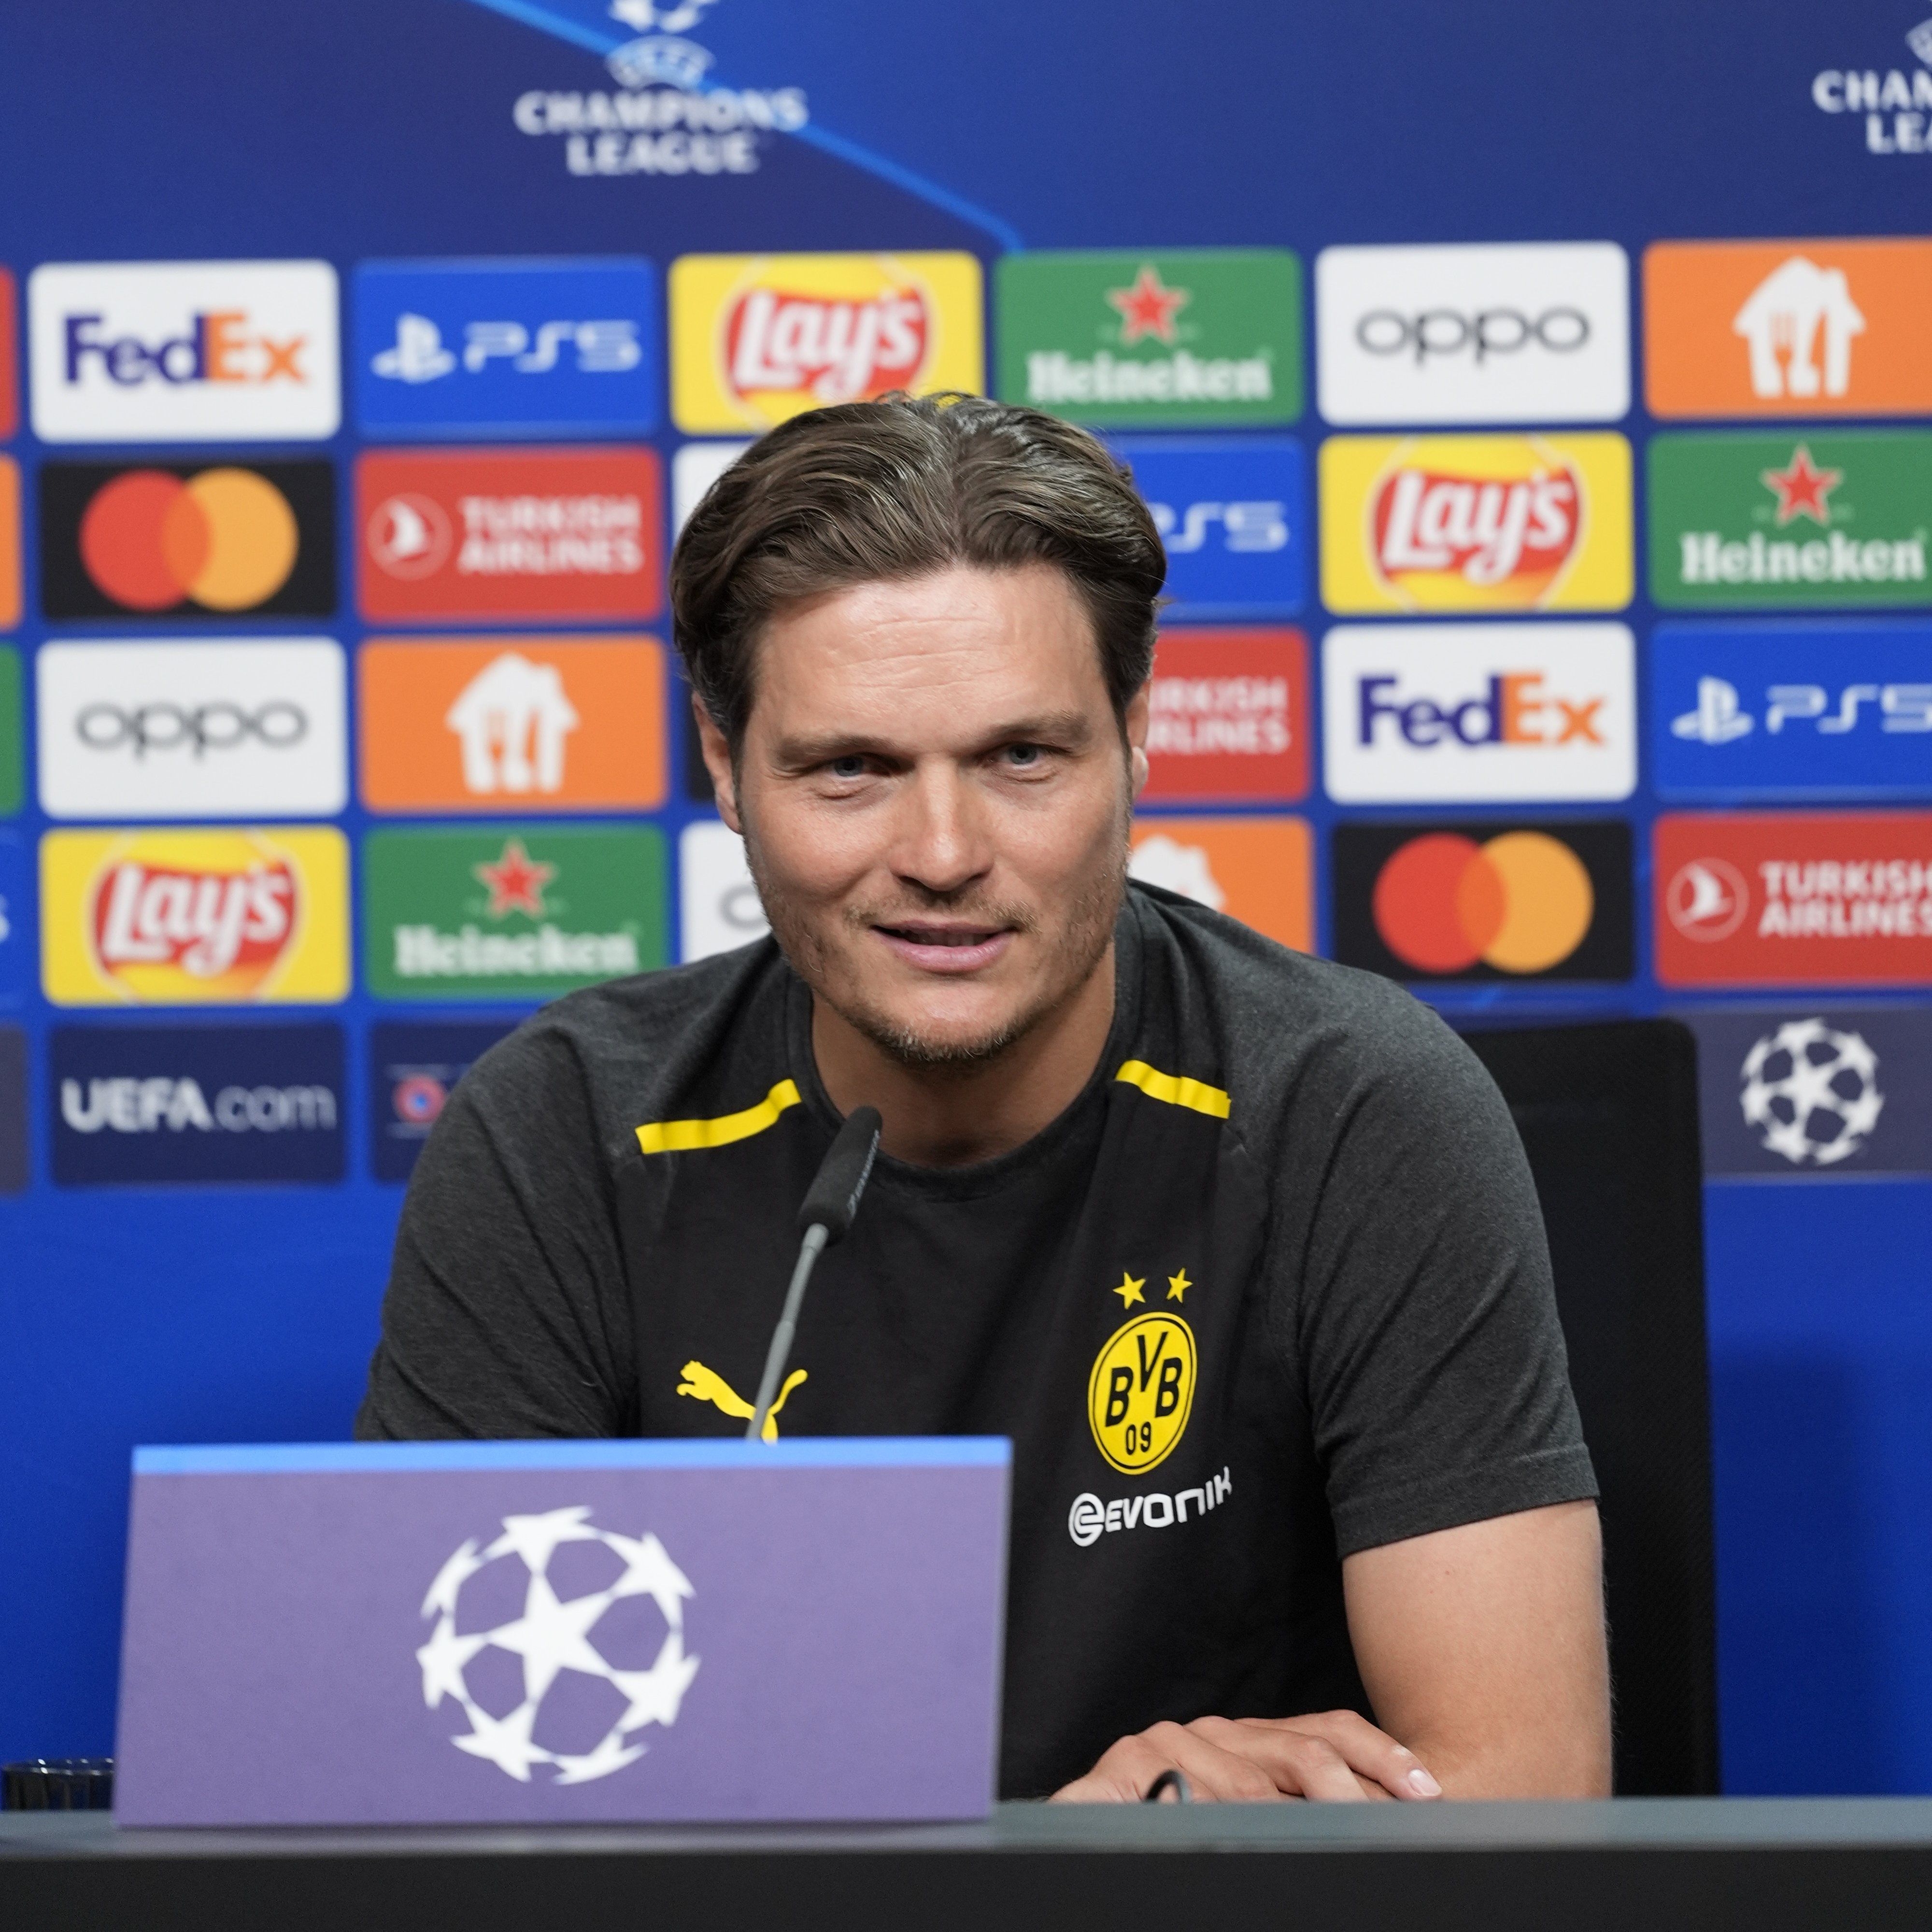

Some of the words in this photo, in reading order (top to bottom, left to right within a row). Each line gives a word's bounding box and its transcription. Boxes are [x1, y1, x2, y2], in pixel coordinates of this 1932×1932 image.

[514, 88, 809, 134] CHAMPIONS
[567, 132, 758, 175] LEAGUE
[64, 312, 303, 386] FedEx
[464, 321, 641, 372] PS5
[733, 286, 925, 405] Lay's
[1027, 350, 1271, 402] Heineken
[459, 495, 642, 533] TURKISH
[1382, 469, 1576, 584] Lay's
[458, 535, 644, 575] AIRLINES
[1680, 530, 1926, 583] Heineken
[1357, 673, 1603, 749] FedEx
[1766, 684, 1932, 733] PS5
[101, 860, 289, 978] Lay's
[394, 923, 639, 976] Heineken
[61, 1077, 337, 1132] UEFA.com
[1105, 1331, 1183, 1428] BVB
[1125, 1421, 1152, 1456] 09
